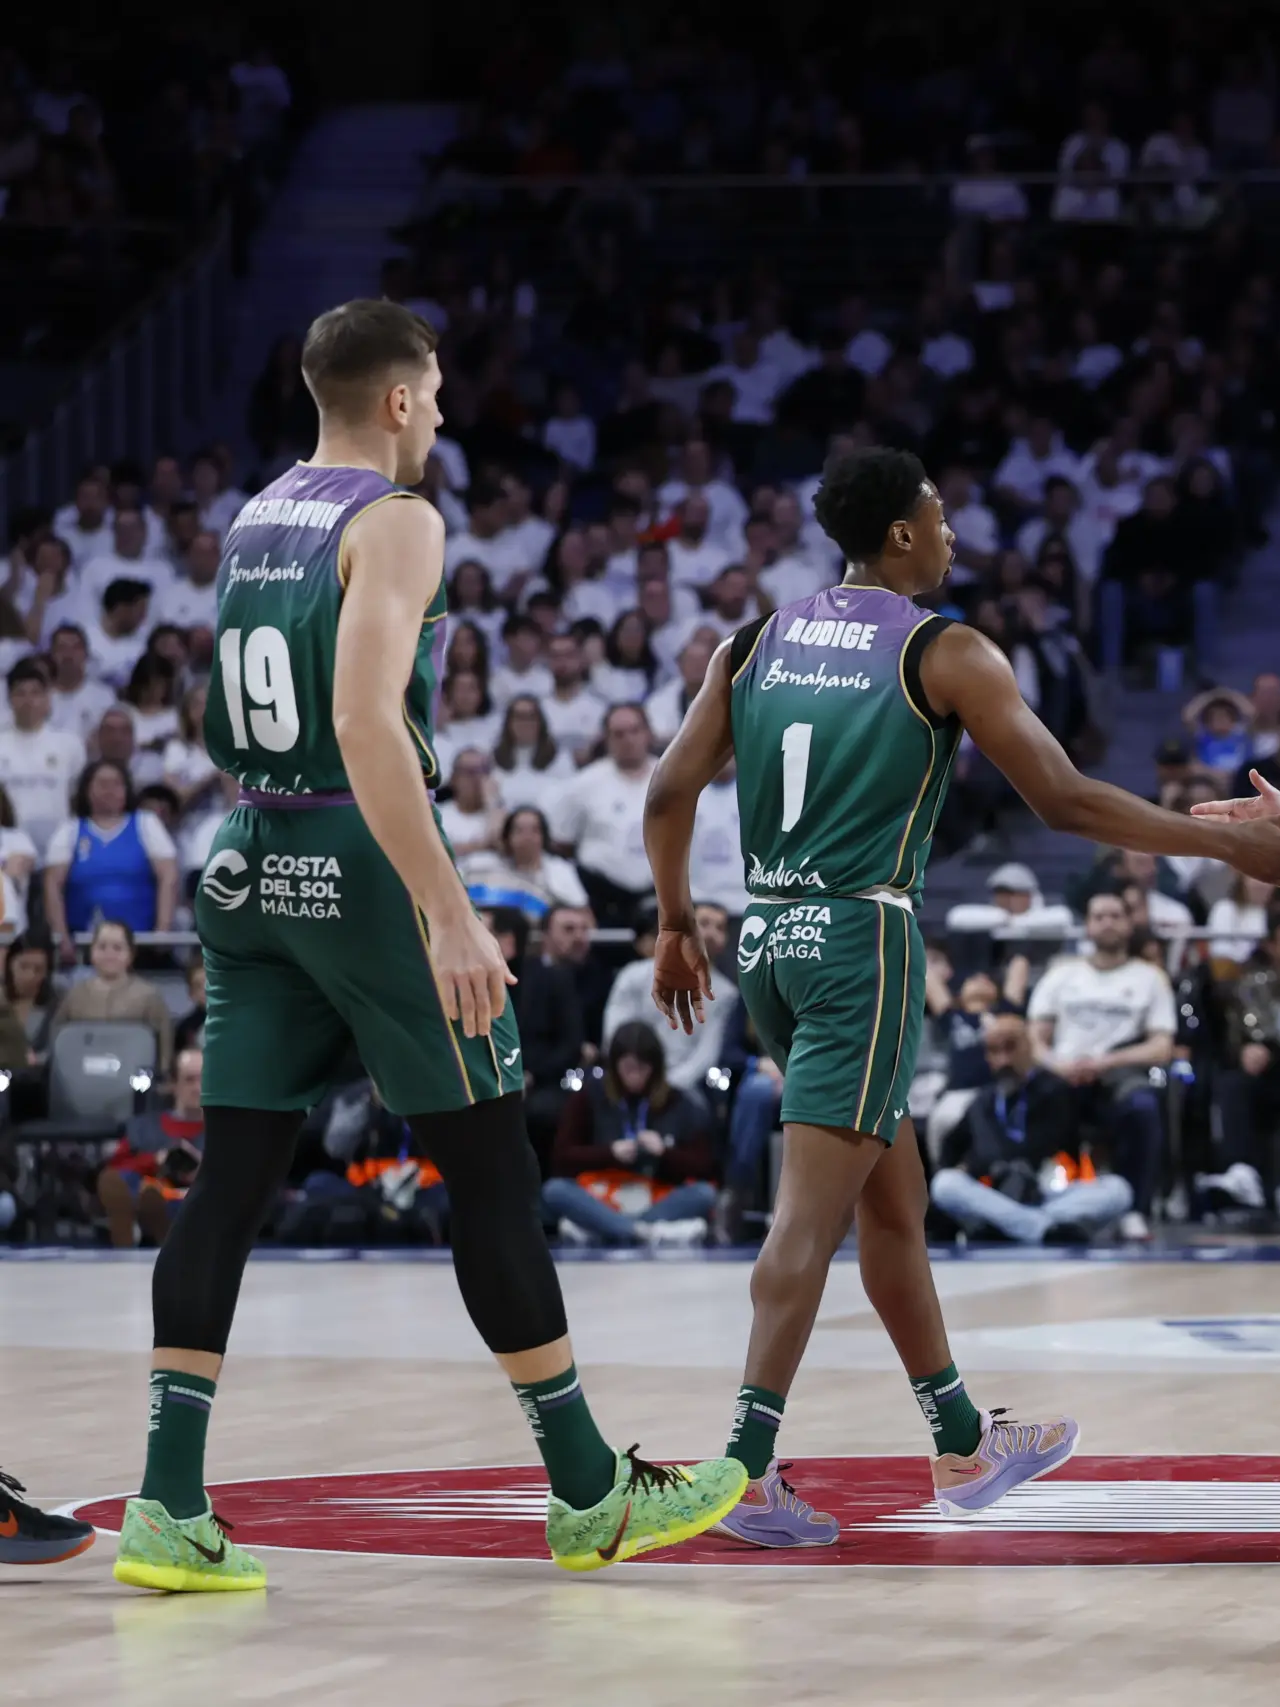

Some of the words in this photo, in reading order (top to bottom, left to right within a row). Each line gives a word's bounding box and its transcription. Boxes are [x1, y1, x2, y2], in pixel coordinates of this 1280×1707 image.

[783, 617, 879, 650] AUDIGE
[219, 626, 299, 752] 19
[781, 722, 813, 832] 1
[262, 854, 342, 877] COSTA
[260, 878, 296, 897] DEL
[300, 880, 341, 899] SOL
[260, 897, 341, 918] MÁLAGA
[790, 925, 826, 943] SOL
